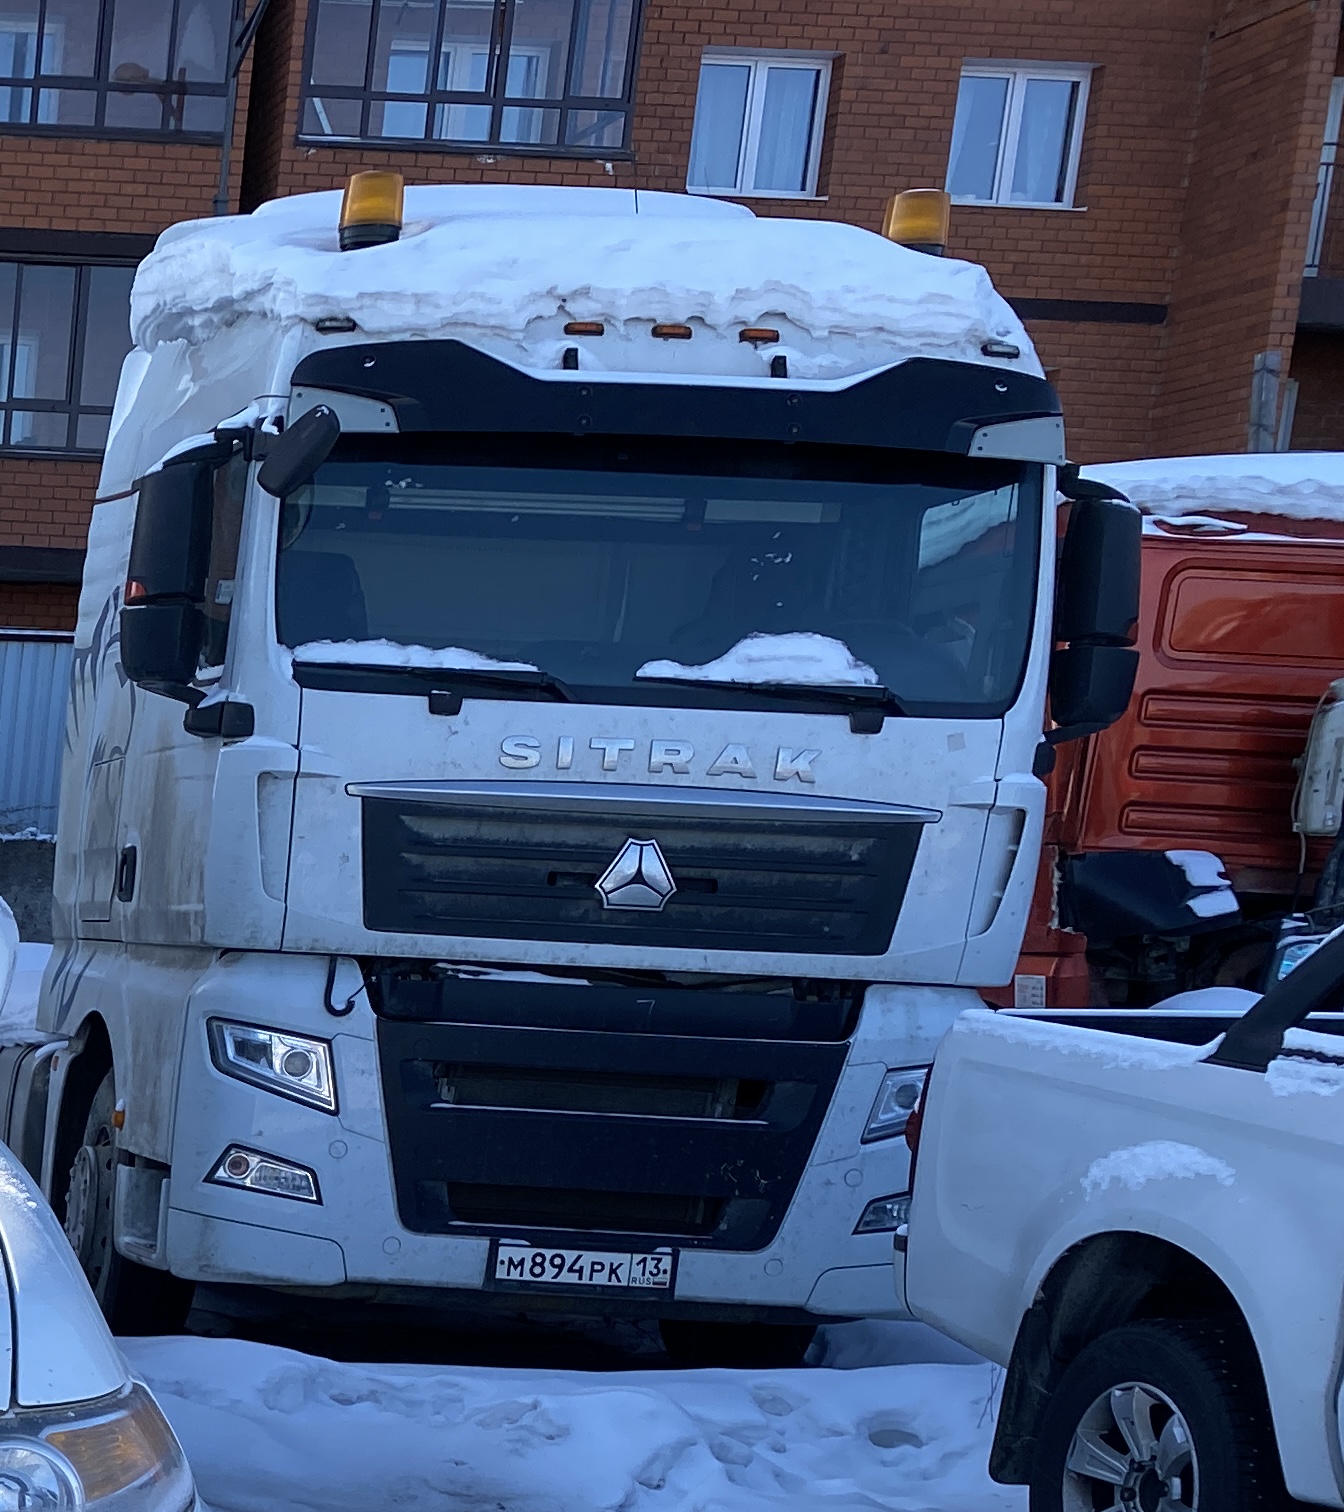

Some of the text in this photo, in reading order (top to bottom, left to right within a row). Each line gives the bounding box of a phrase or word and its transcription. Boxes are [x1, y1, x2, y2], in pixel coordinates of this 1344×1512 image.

[498, 735, 823, 783] SITRAK
[636, 1256, 662, 1278] 13
[631, 1276, 652, 1286] RUS
